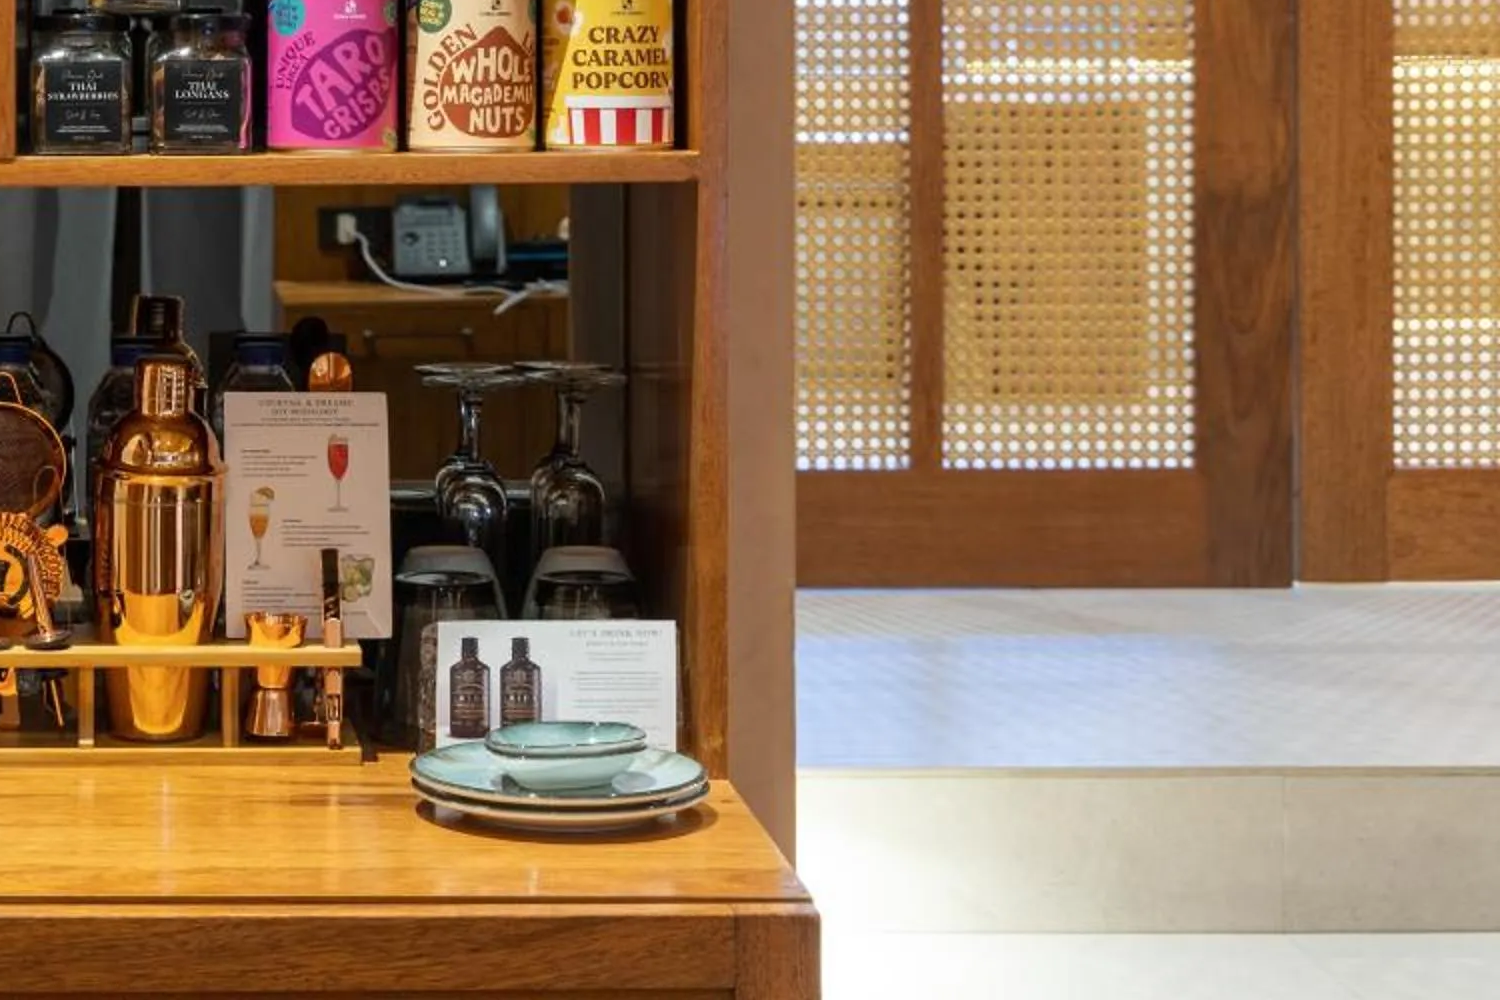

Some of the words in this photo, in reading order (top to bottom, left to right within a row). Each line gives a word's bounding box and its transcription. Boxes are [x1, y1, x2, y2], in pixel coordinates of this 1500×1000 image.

[588, 25, 661, 45] CRAZY
[275, 30, 317, 90] UNIQUE
[451, 45, 532, 84] WHOLE
[572, 47, 668, 68] CARAMEL
[70, 82, 98, 91] THAI
[296, 35, 385, 121] TARO
[423, 22, 477, 131] GOLDEN
[572, 70, 670, 90] POPCORN
[323, 67, 390, 140] CRISPS
[469, 105, 525, 134] NUTS
